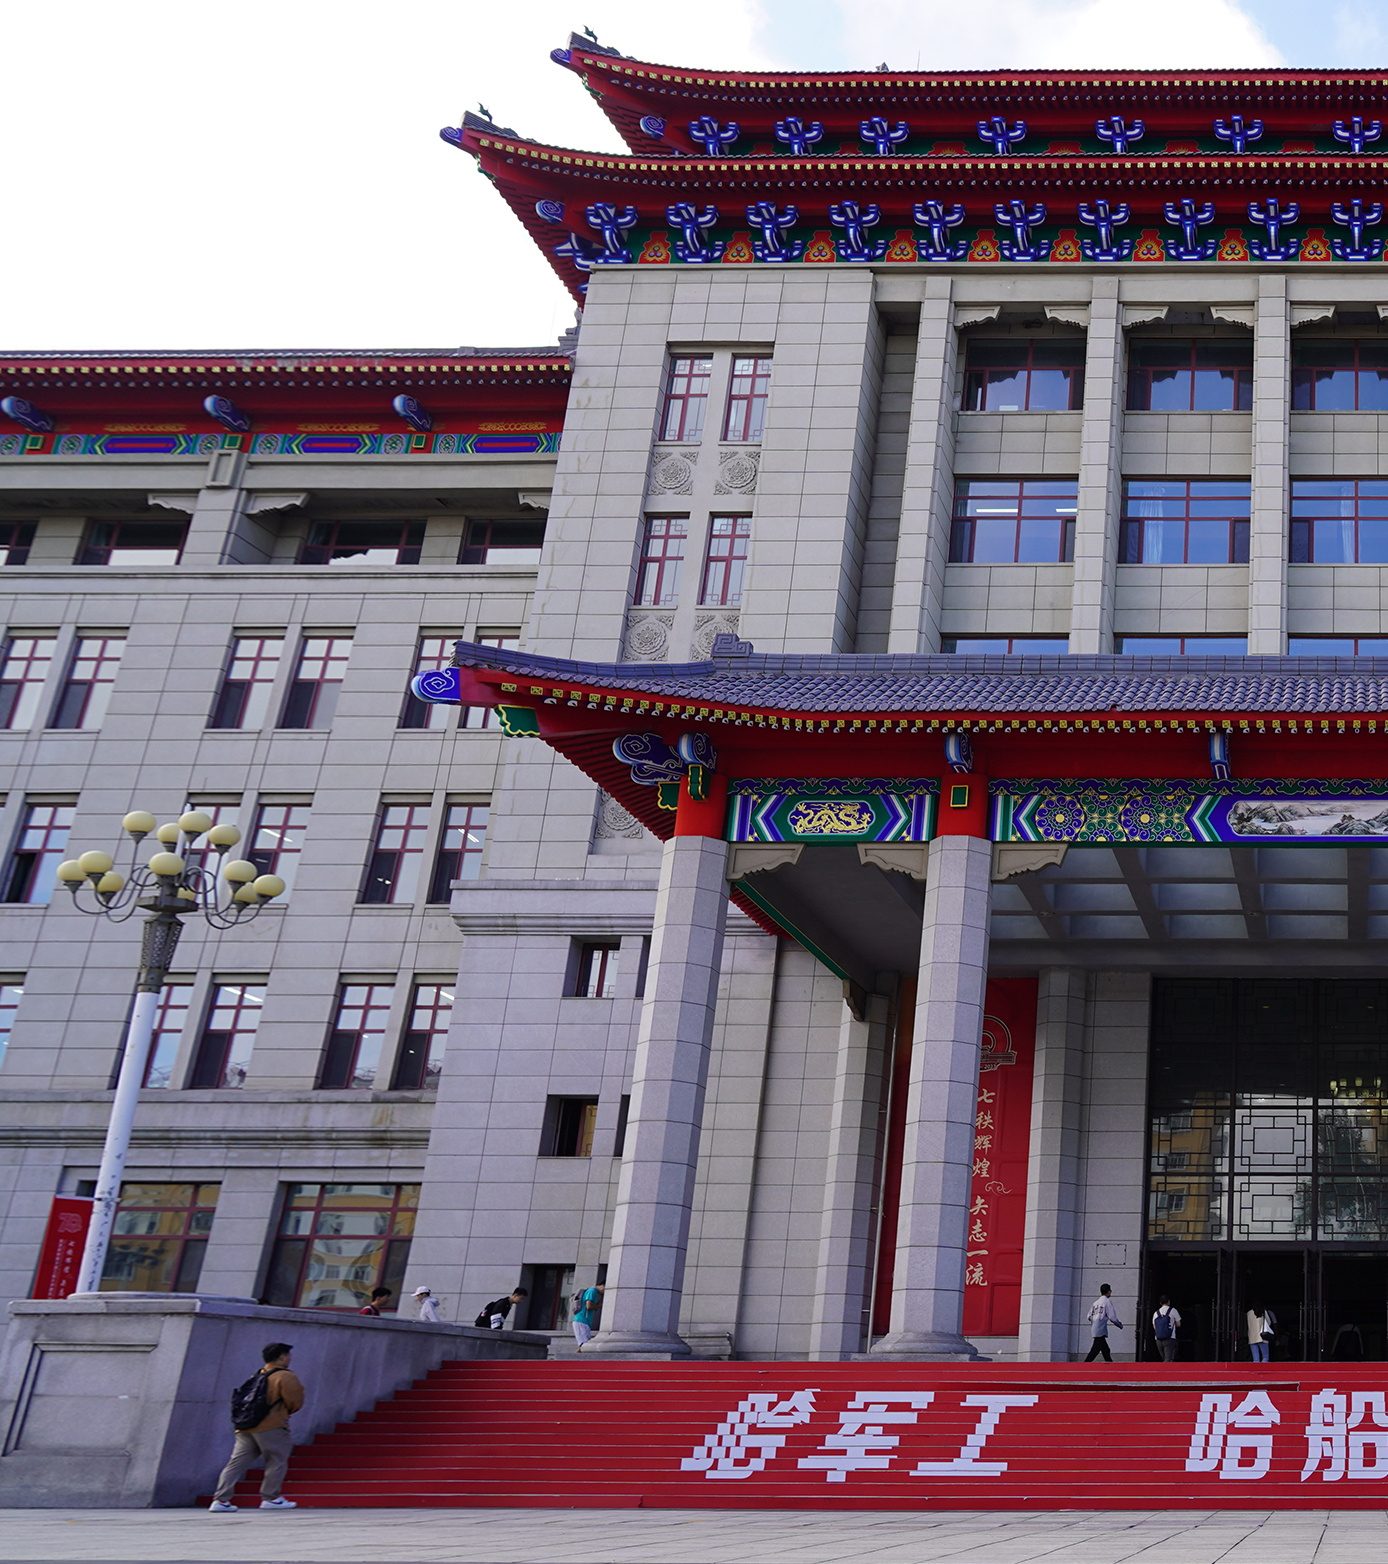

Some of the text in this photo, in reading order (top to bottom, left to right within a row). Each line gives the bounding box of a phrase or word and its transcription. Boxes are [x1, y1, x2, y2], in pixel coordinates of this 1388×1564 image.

[965, 1088, 996, 1286] 七秩辉煌 矢志一流
[681, 1388, 1039, 1482] 哈军工
